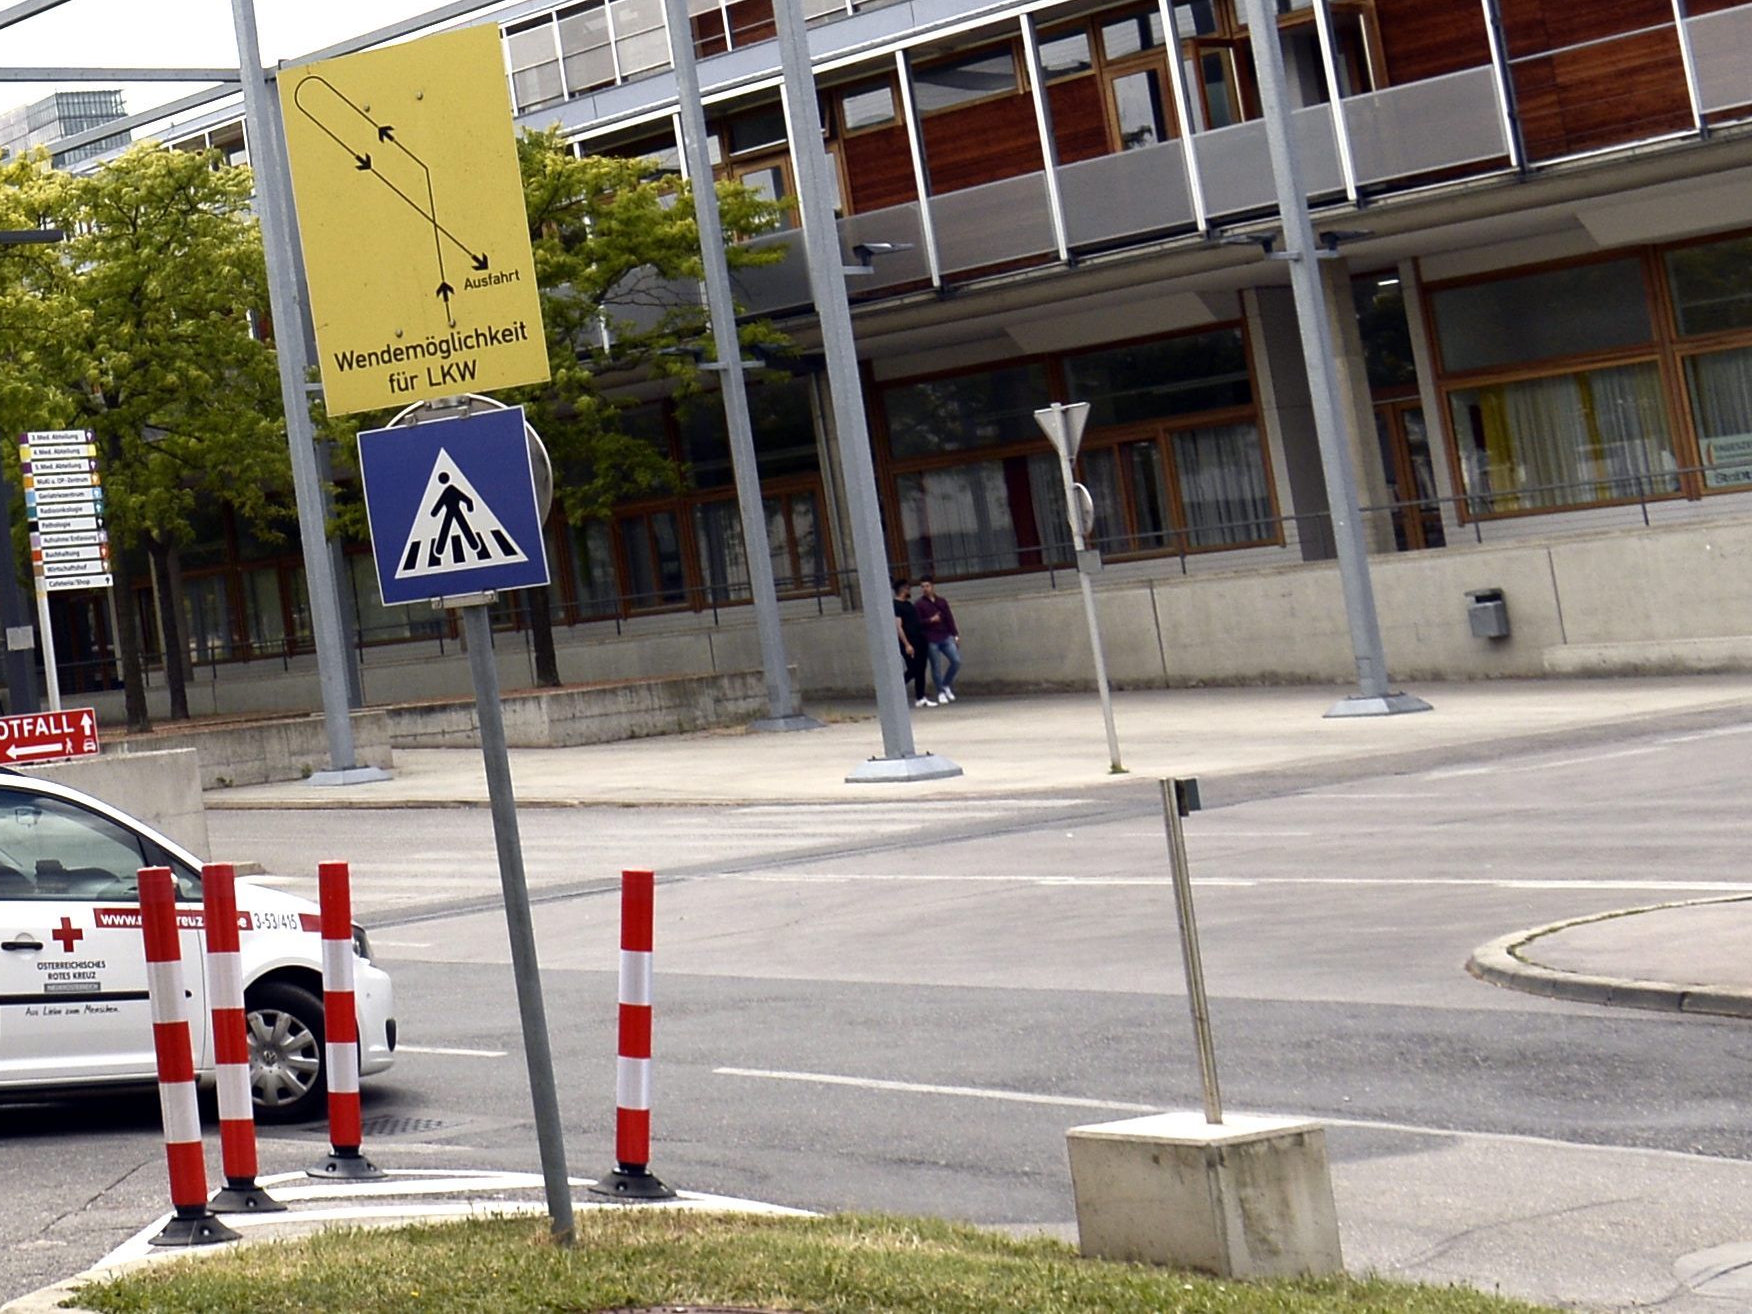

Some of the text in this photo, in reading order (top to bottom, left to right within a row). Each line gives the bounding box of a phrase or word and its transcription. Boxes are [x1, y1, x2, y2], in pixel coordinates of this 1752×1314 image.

[464, 268, 521, 291] Ausfahrt
[333, 320, 528, 372] Wendemöglichkeit
[388, 359, 477, 394] für LKW
[253, 912, 298, 930] 3-53/415
[47, 971, 97, 981] ROTES KREUZ
